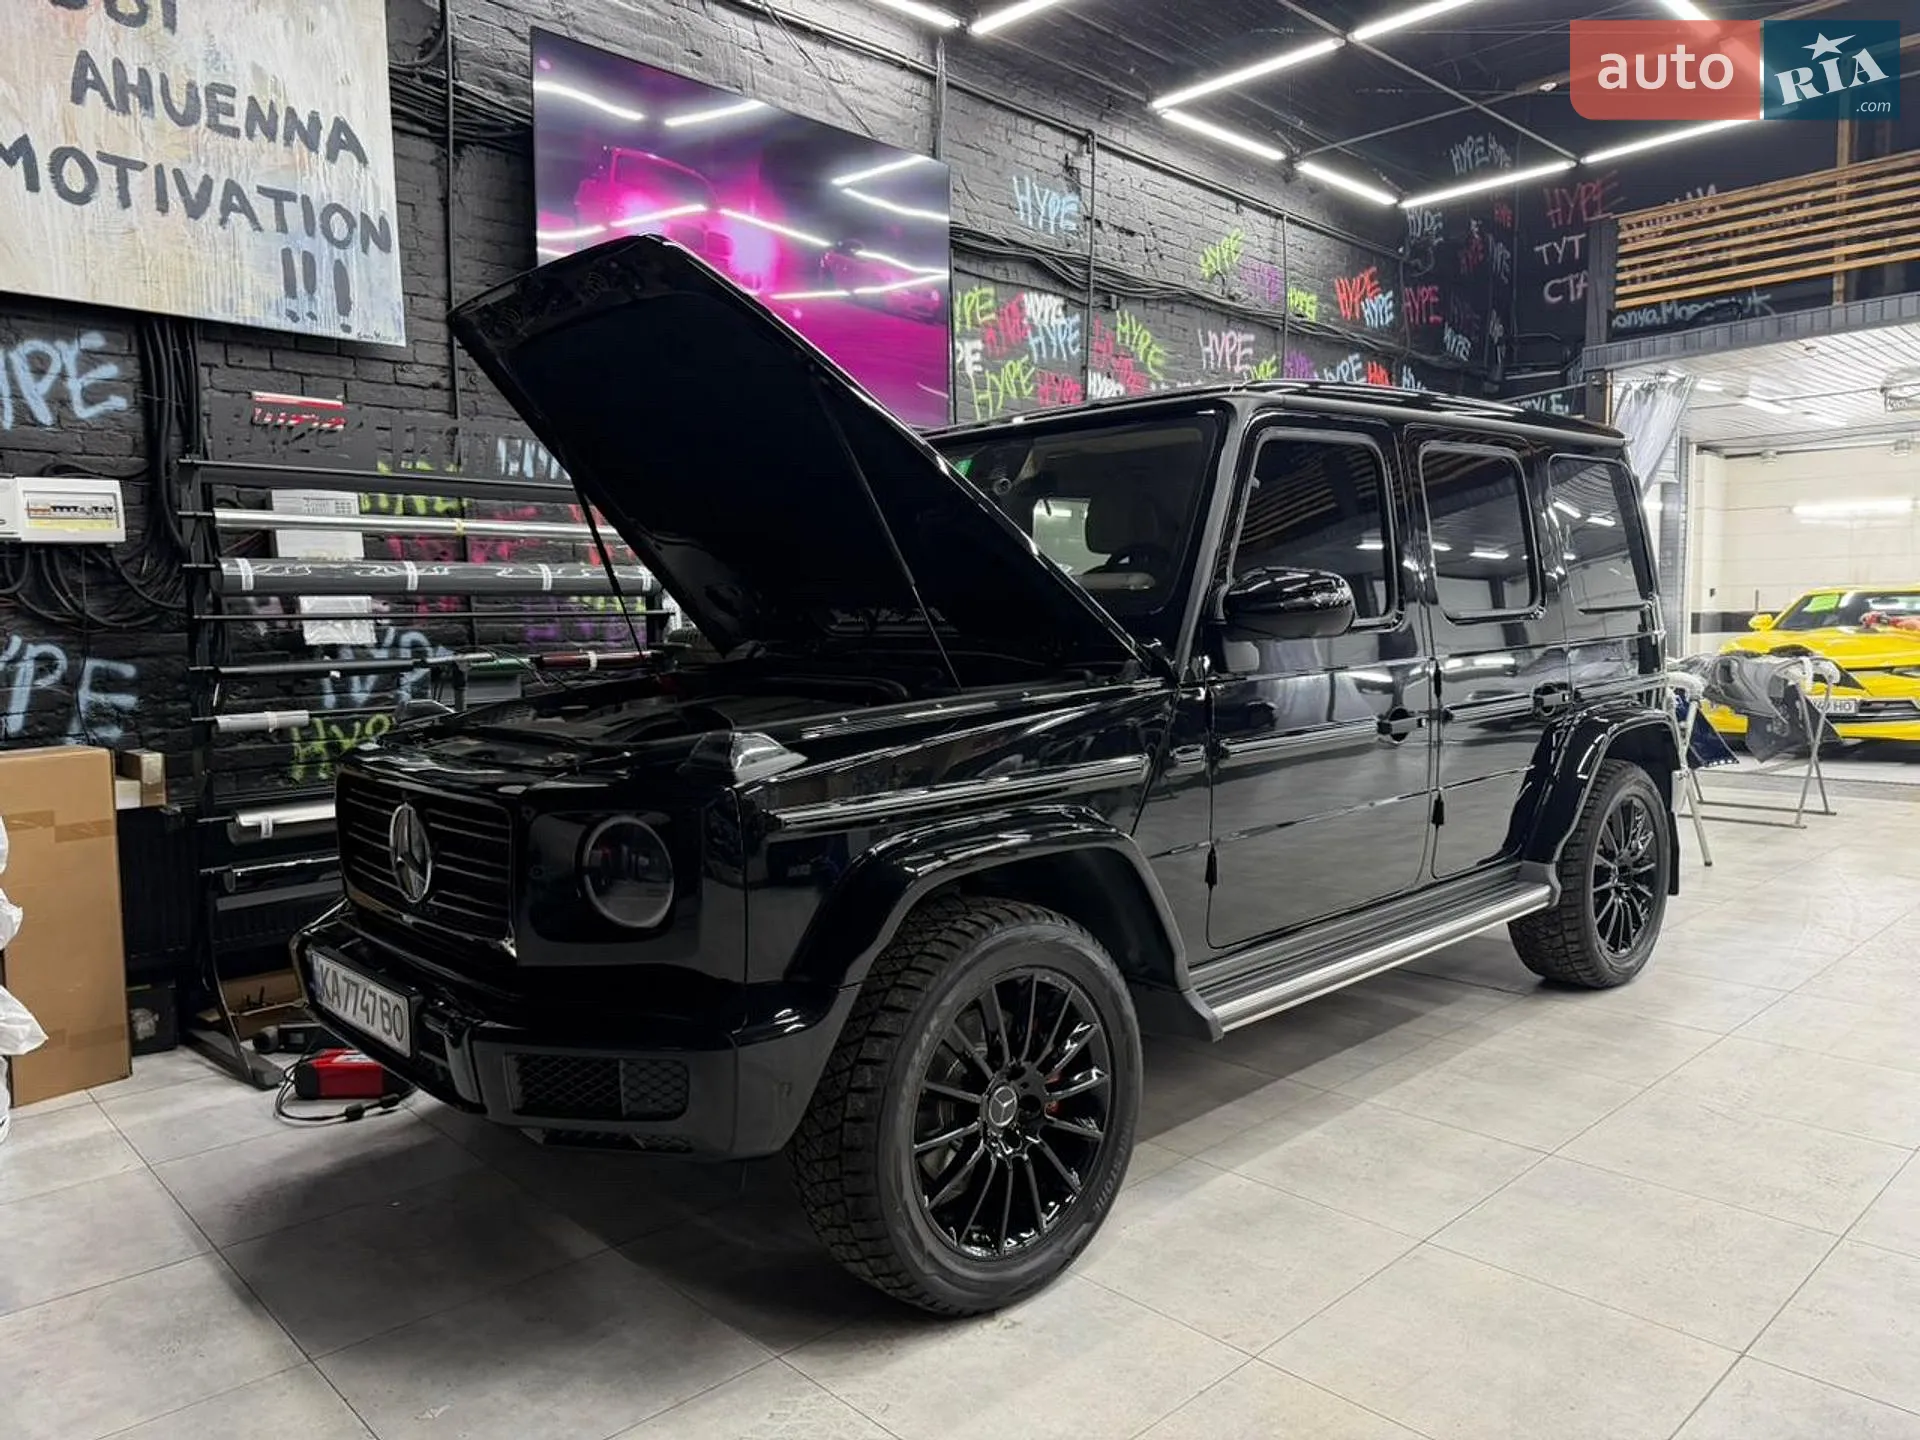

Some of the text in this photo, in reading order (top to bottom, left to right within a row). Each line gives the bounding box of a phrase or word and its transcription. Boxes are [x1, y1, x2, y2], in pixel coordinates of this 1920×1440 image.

[70, 49, 369, 167] AHUENNA
[1449, 134, 1489, 176] HYPE
[1012, 174, 1081, 235] HYPE
[1544, 170, 1626, 228] HYPE
[1201, 230, 1244, 282] HYPE
[1335, 266, 1382, 321] HYPE
[1361, 290, 1394, 329] HYPE
[1405, 285, 1443, 325] HYPE
[1028, 313, 1081, 364] HYPE
[1114, 309, 1170, 380] HYPE
[1197, 327, 1256, 375] HYPE
[971, 354, 1037, 421] HYPE
